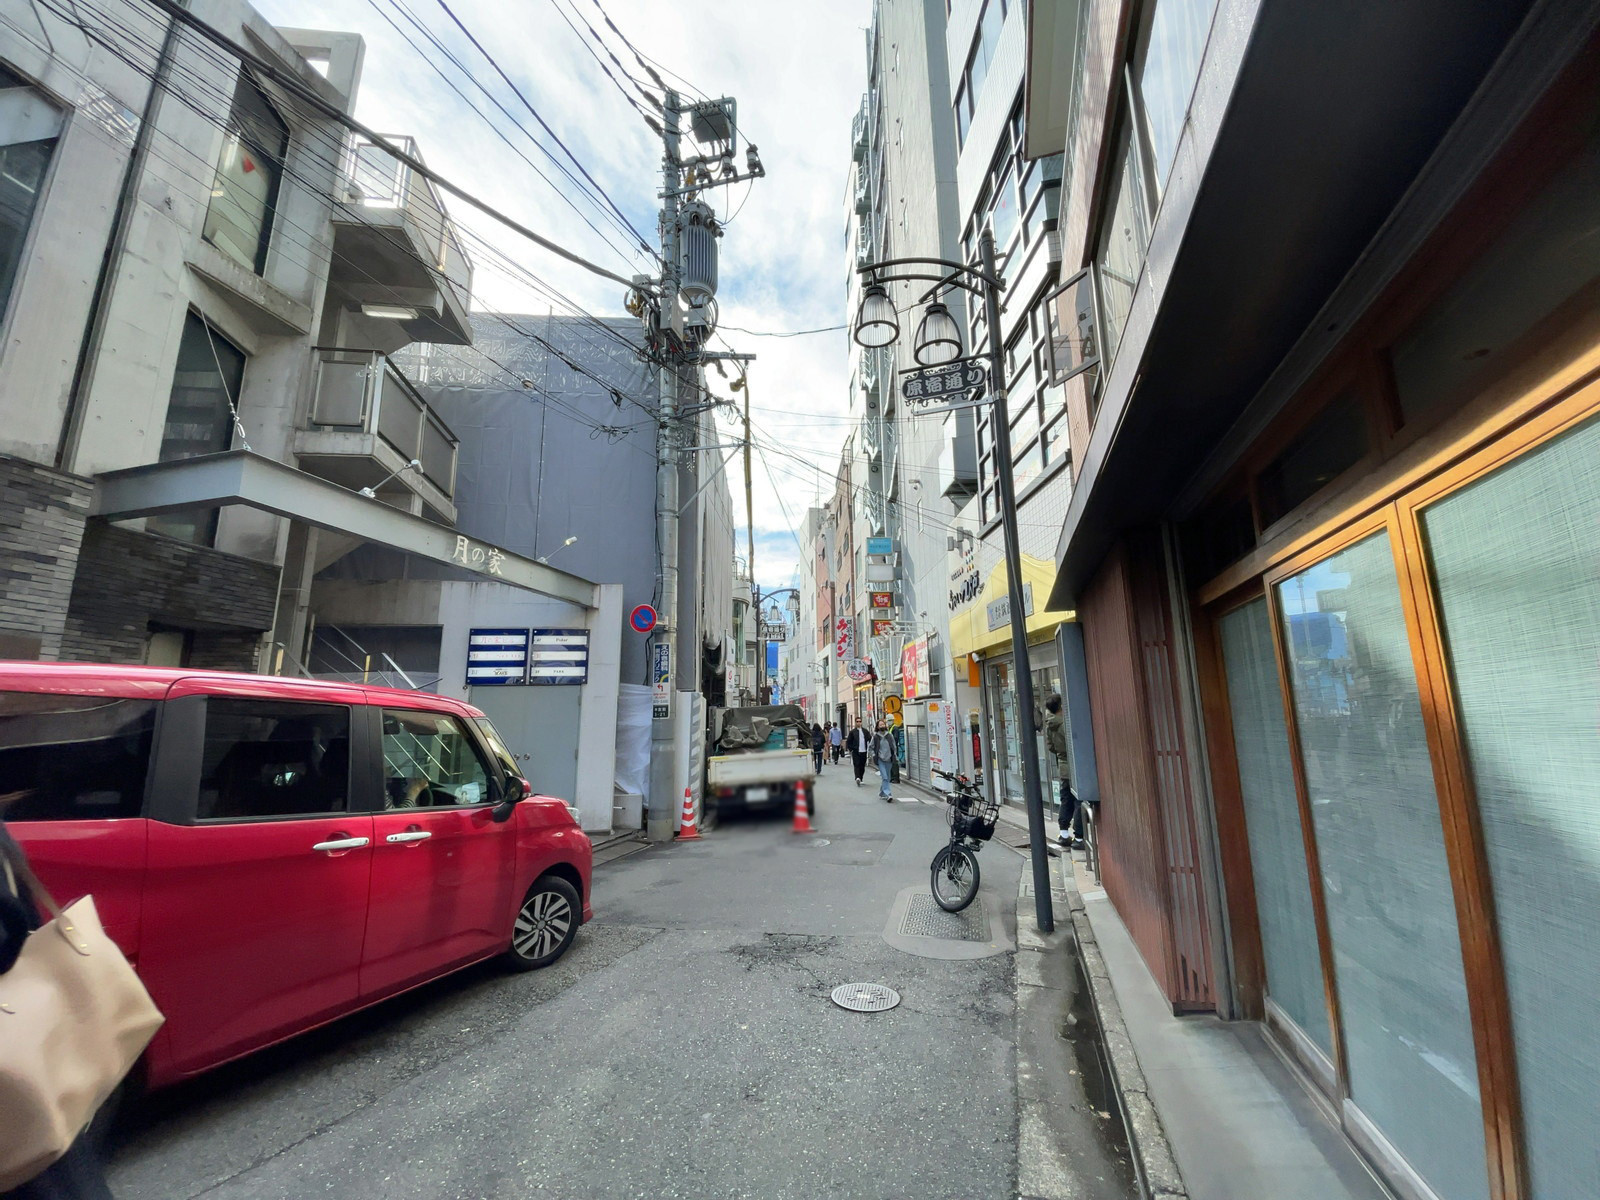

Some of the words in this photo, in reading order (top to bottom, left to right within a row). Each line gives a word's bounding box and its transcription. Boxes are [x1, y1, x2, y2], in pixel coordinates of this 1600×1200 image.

[905, 369, 985, 396] 原宿通り
[452, 534, 506, 575] 月の家
[836, 618, 848, 658] ラーメン
